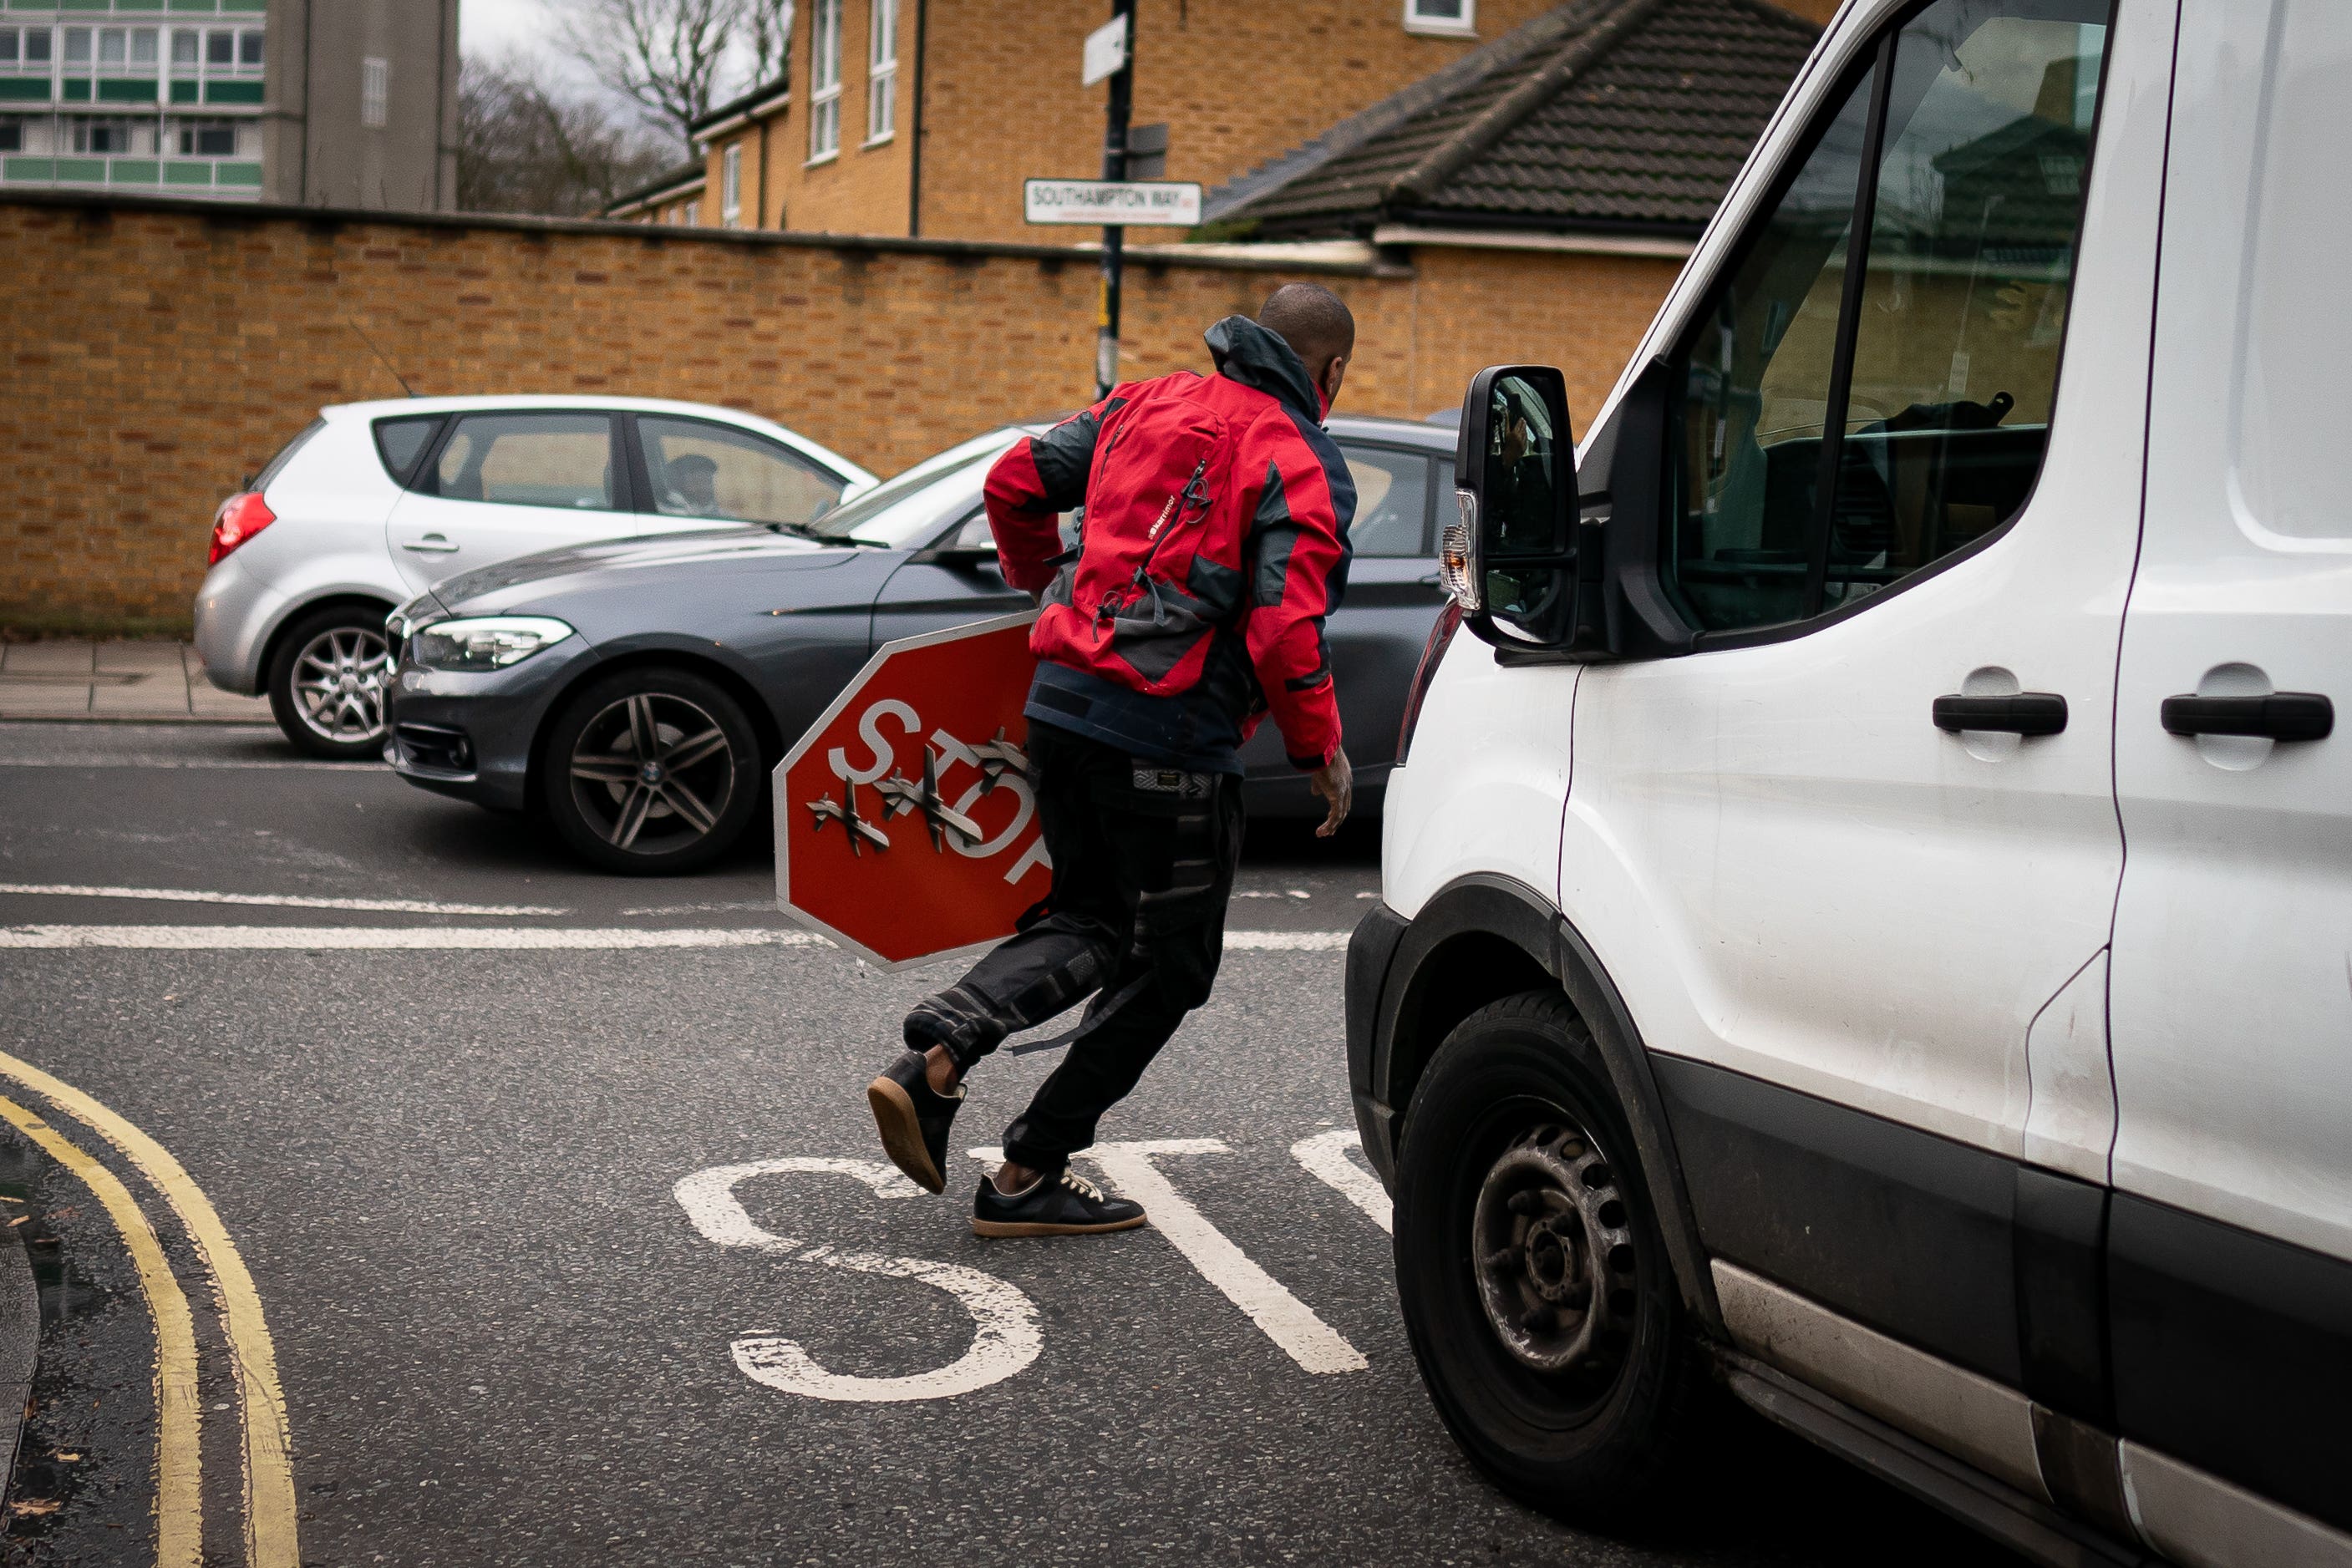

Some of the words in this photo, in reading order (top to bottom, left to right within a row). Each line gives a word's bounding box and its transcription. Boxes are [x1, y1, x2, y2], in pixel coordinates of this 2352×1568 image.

[1034, 186, 1146, 206] SOUTHAMPTON
[1151, 190, 1181, 206] WAY
[1152, 495, 1176, 530] karrimor
[672, 1130, 1394, 1403] ST
